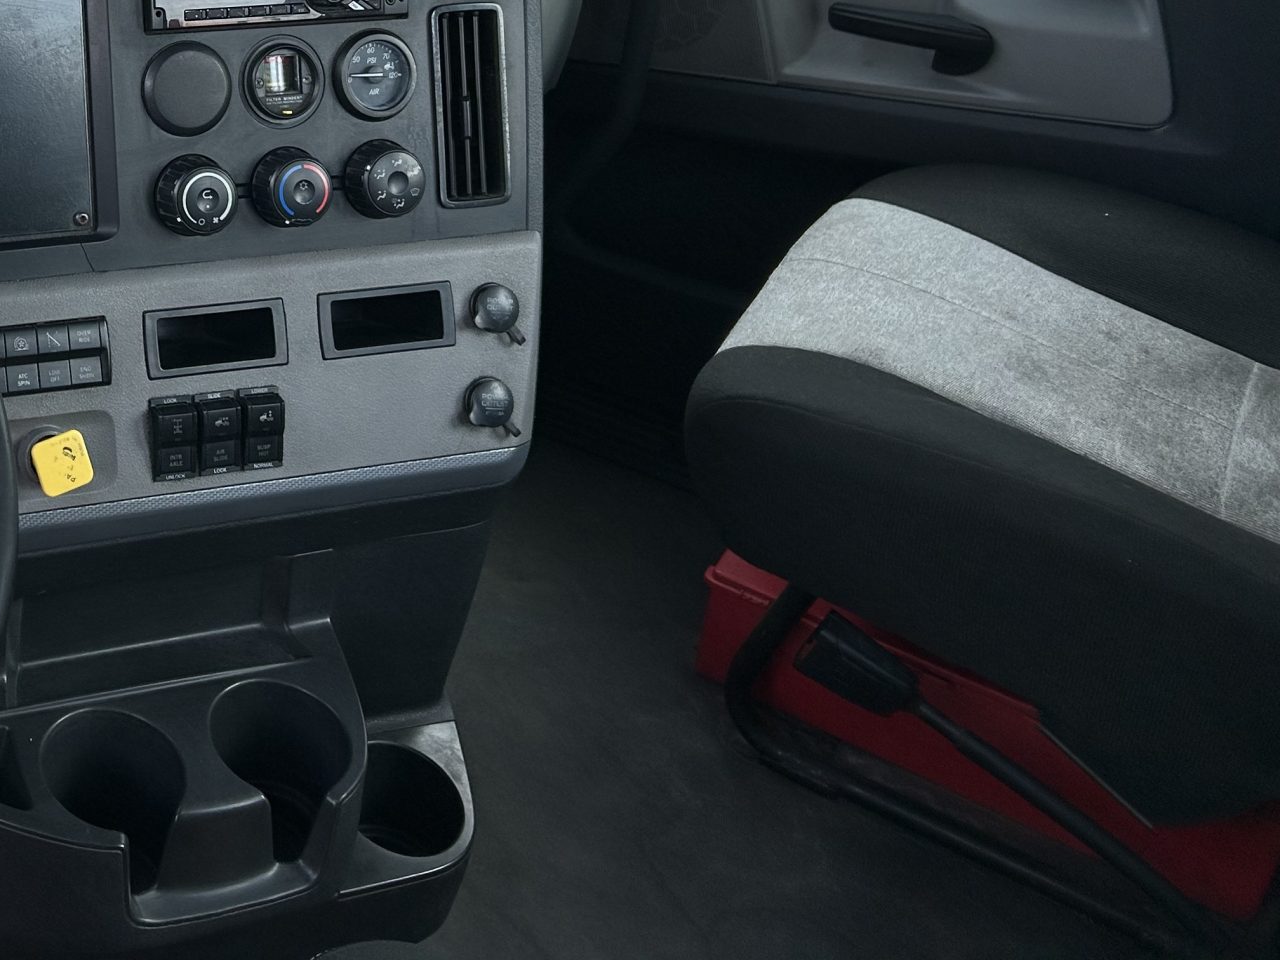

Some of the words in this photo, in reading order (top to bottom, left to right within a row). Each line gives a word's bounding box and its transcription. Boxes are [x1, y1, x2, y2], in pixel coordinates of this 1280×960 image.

[366, 46, 375, 54] 60
[351, 55, 361, 63] 50
[382, 52, 391, 60] 70
[368, 87, 380, 96] AIR
[163, 397, 177, 405] LOCK
[165, 473, 186, 481] UNLOCK
